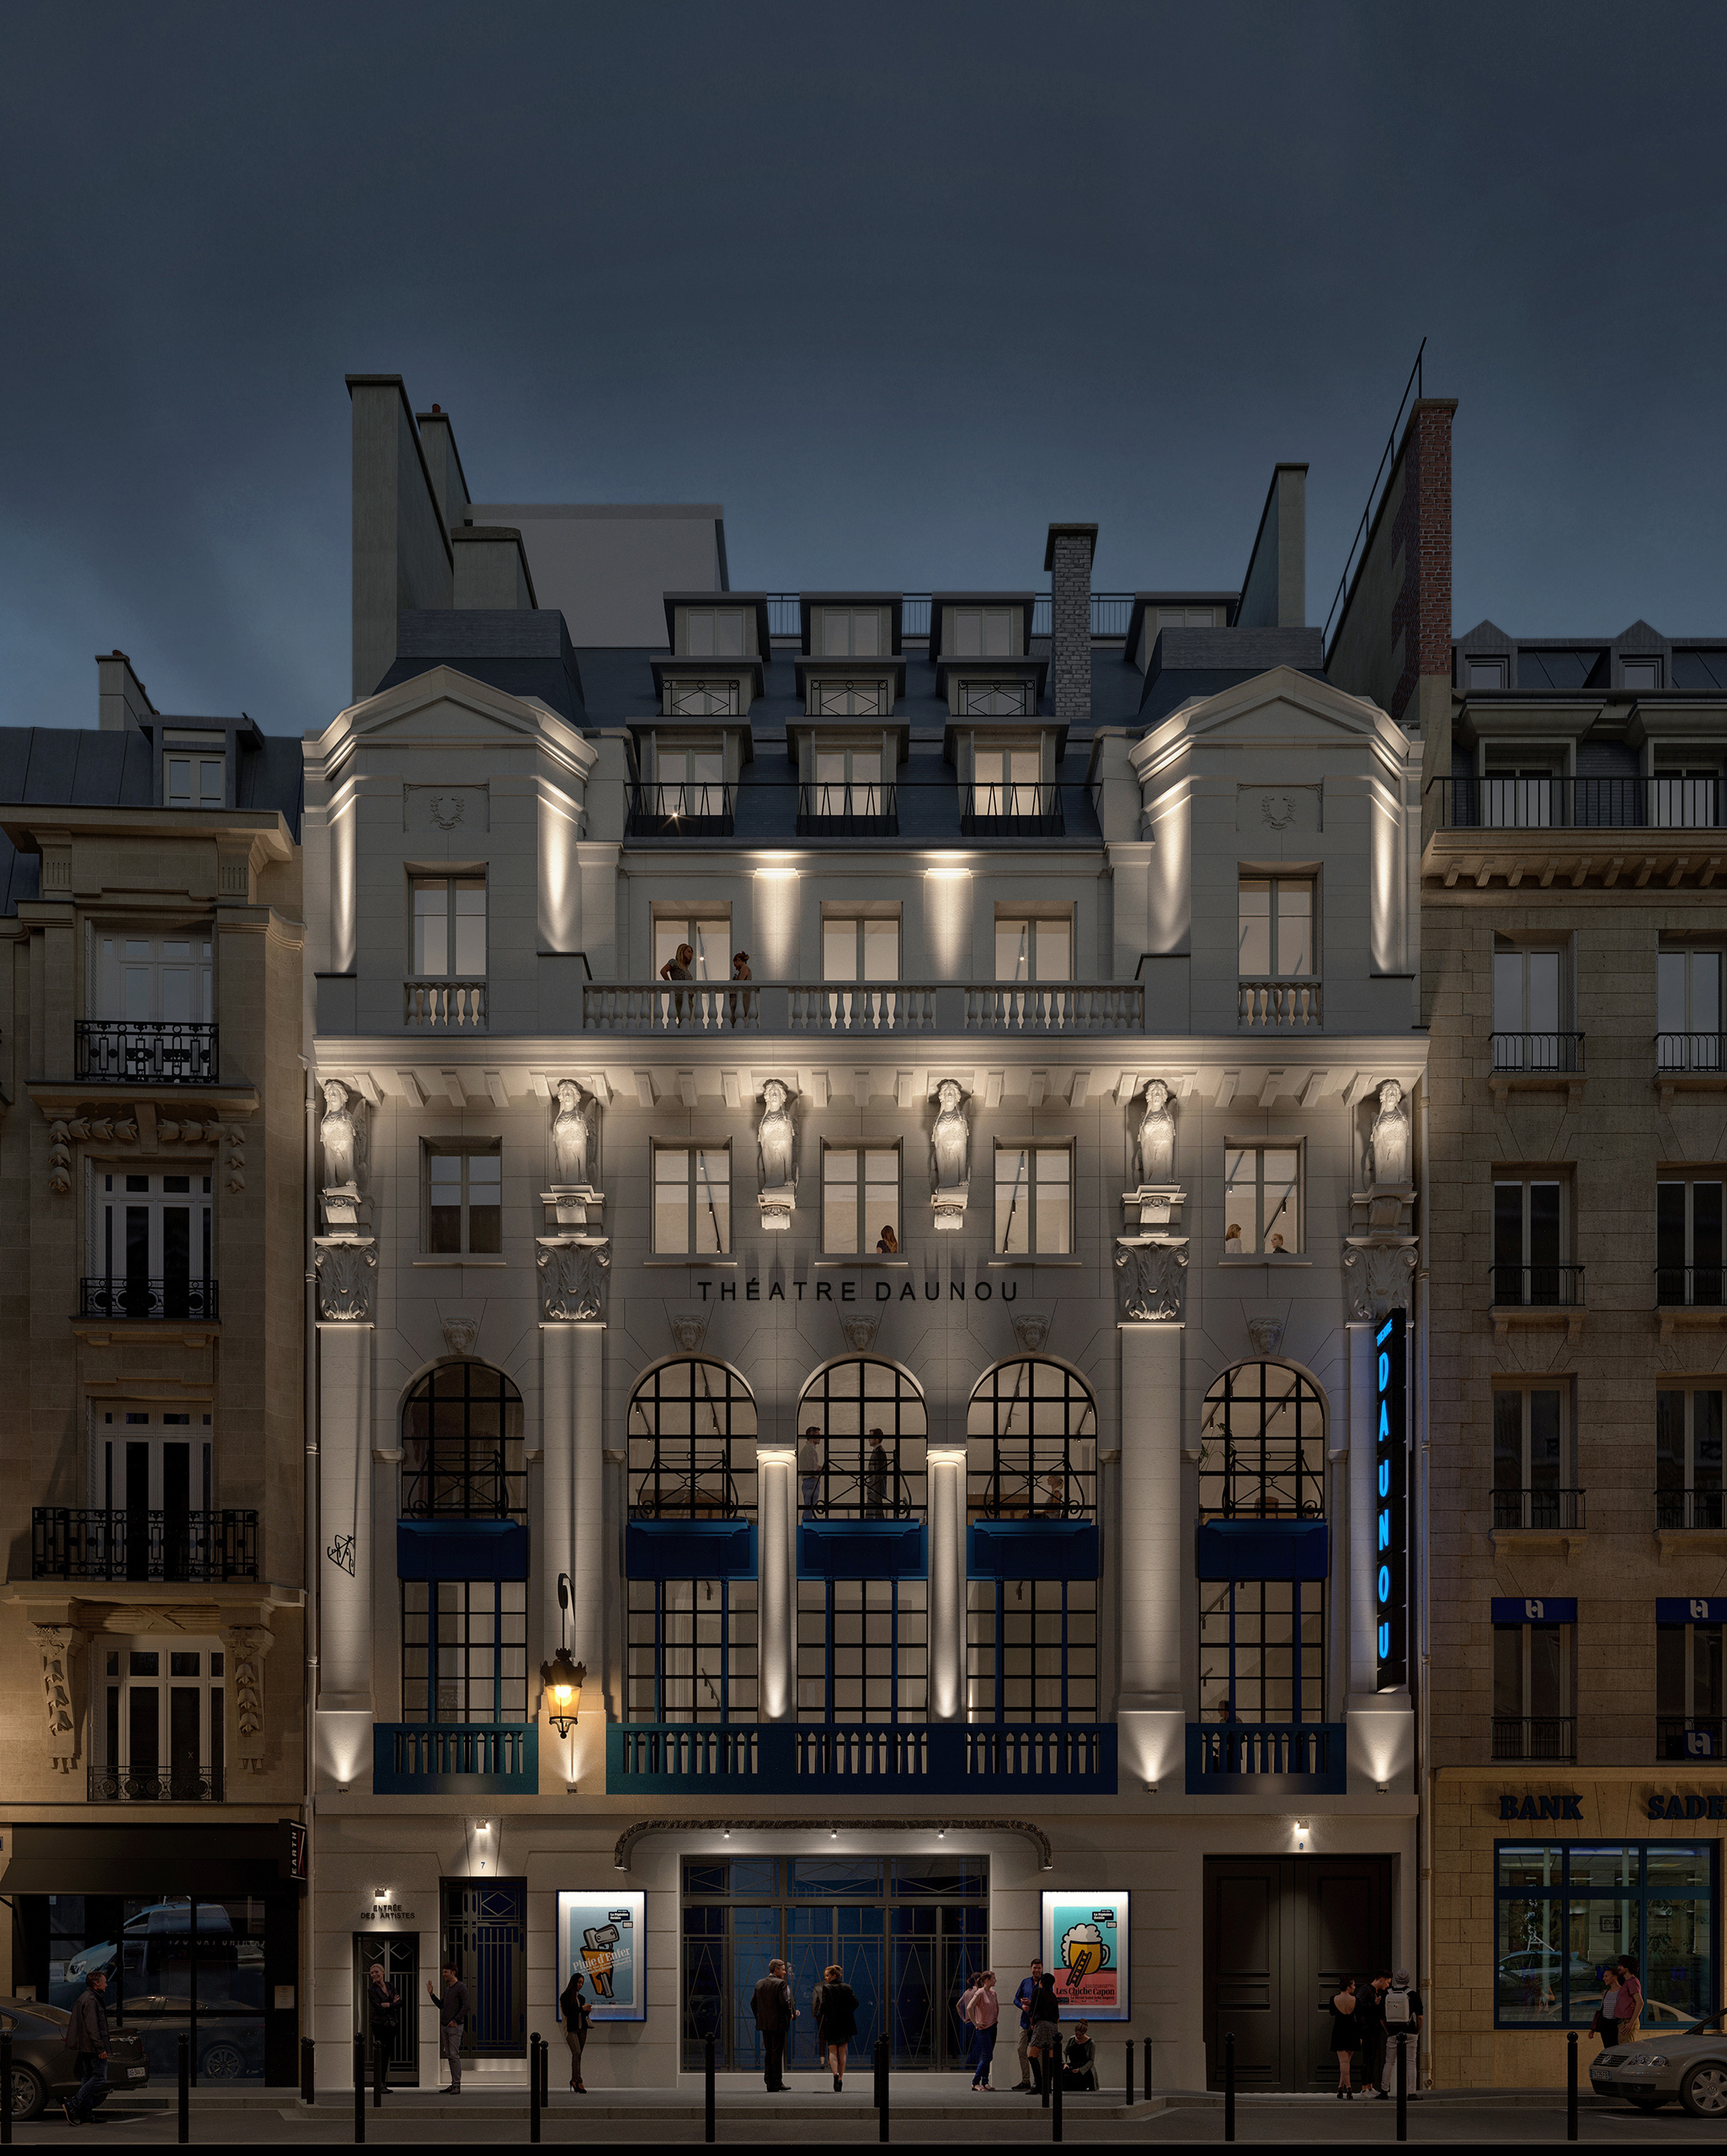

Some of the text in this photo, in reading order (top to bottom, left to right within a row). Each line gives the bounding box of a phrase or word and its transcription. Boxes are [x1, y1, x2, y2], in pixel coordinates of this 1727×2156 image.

[697, 1278, 1017, 1302] THÉATRE DAUNOU
[1378, 1352, 1389, 1659] DAUNOU
[1499, 1795, 1727, 1820] BANK SADE
[373, 1903, 402, 1912] ENTRÉE
[573, 1947, 631, 1972] Pluie d'Enfer
[1068, 1987, 1092, 1995] Chiche
[1092, 1988, 1115, 1997] Capon
